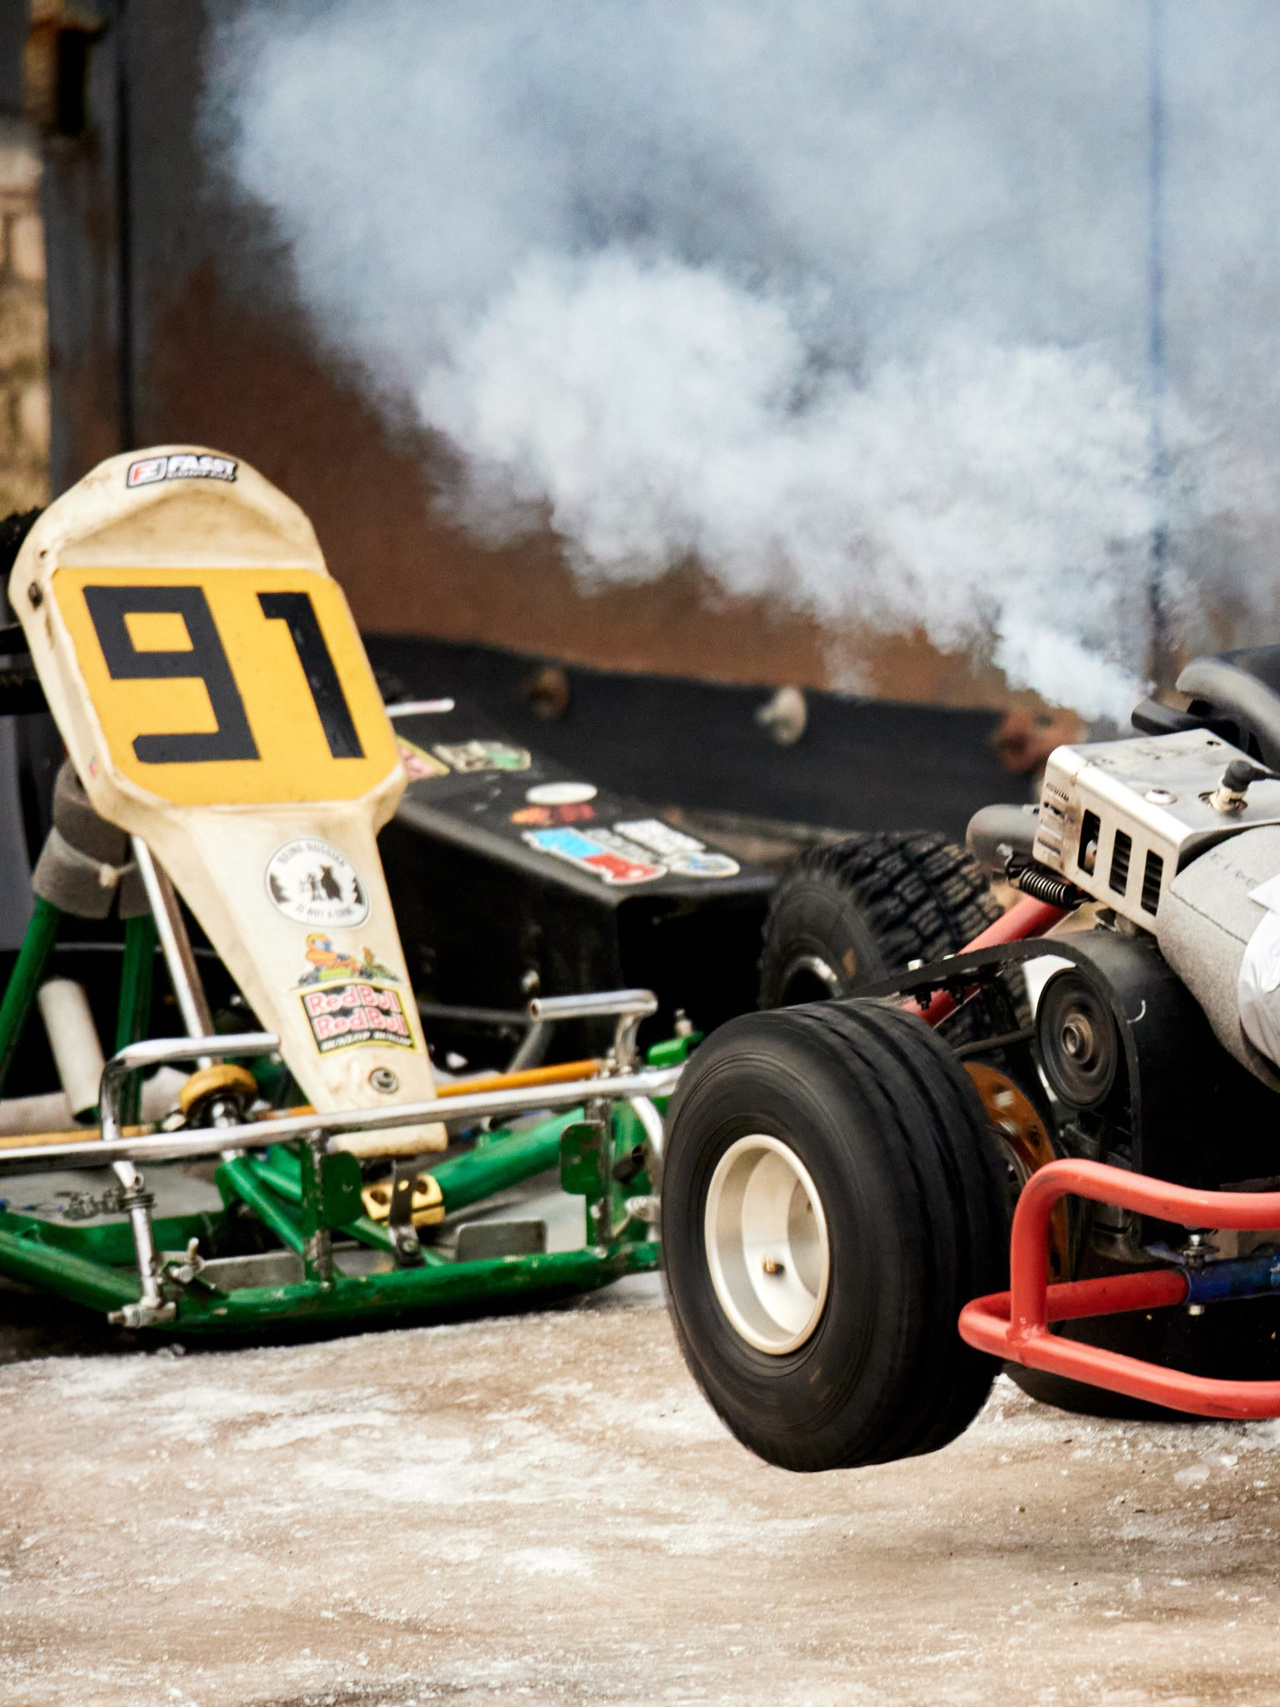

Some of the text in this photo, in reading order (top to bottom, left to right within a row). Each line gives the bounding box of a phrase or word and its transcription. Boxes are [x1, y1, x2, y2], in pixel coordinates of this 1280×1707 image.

[82, 585, 367, 764] 91
[305, 984, 402, 1017] Red Bull
[313, 1006, 410, 1040] Red Bull
